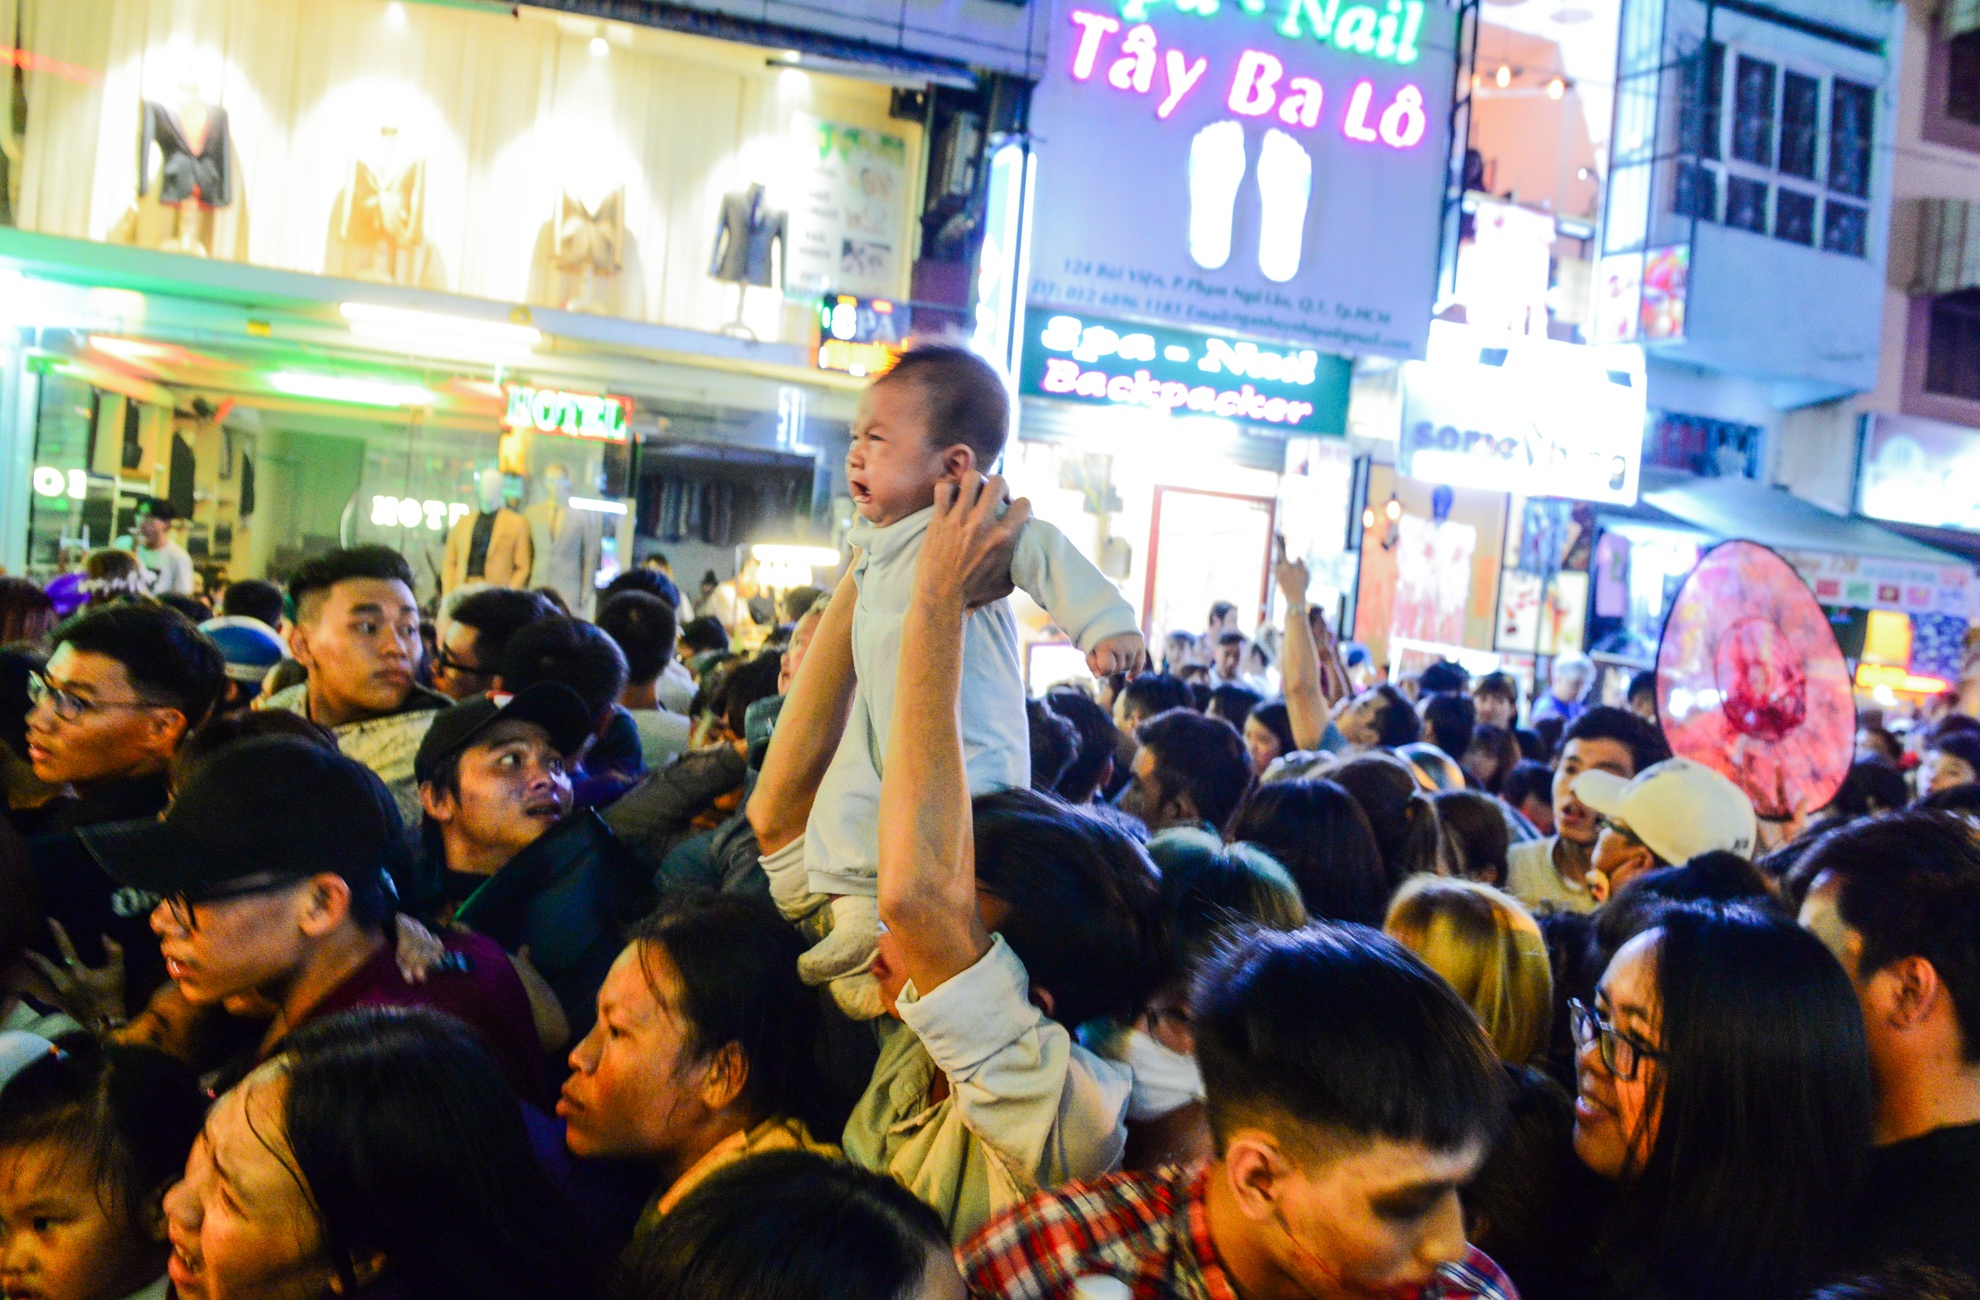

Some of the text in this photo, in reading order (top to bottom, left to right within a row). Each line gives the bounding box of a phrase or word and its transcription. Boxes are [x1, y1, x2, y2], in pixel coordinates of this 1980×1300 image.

[1277, 0, 1424, 64] Nail
[1071, 11, 1426, 147] Tây Ba Lô
[505, 383, 628, 441] HOTEL
[1042, 357, 1313, 424] Backpacker
